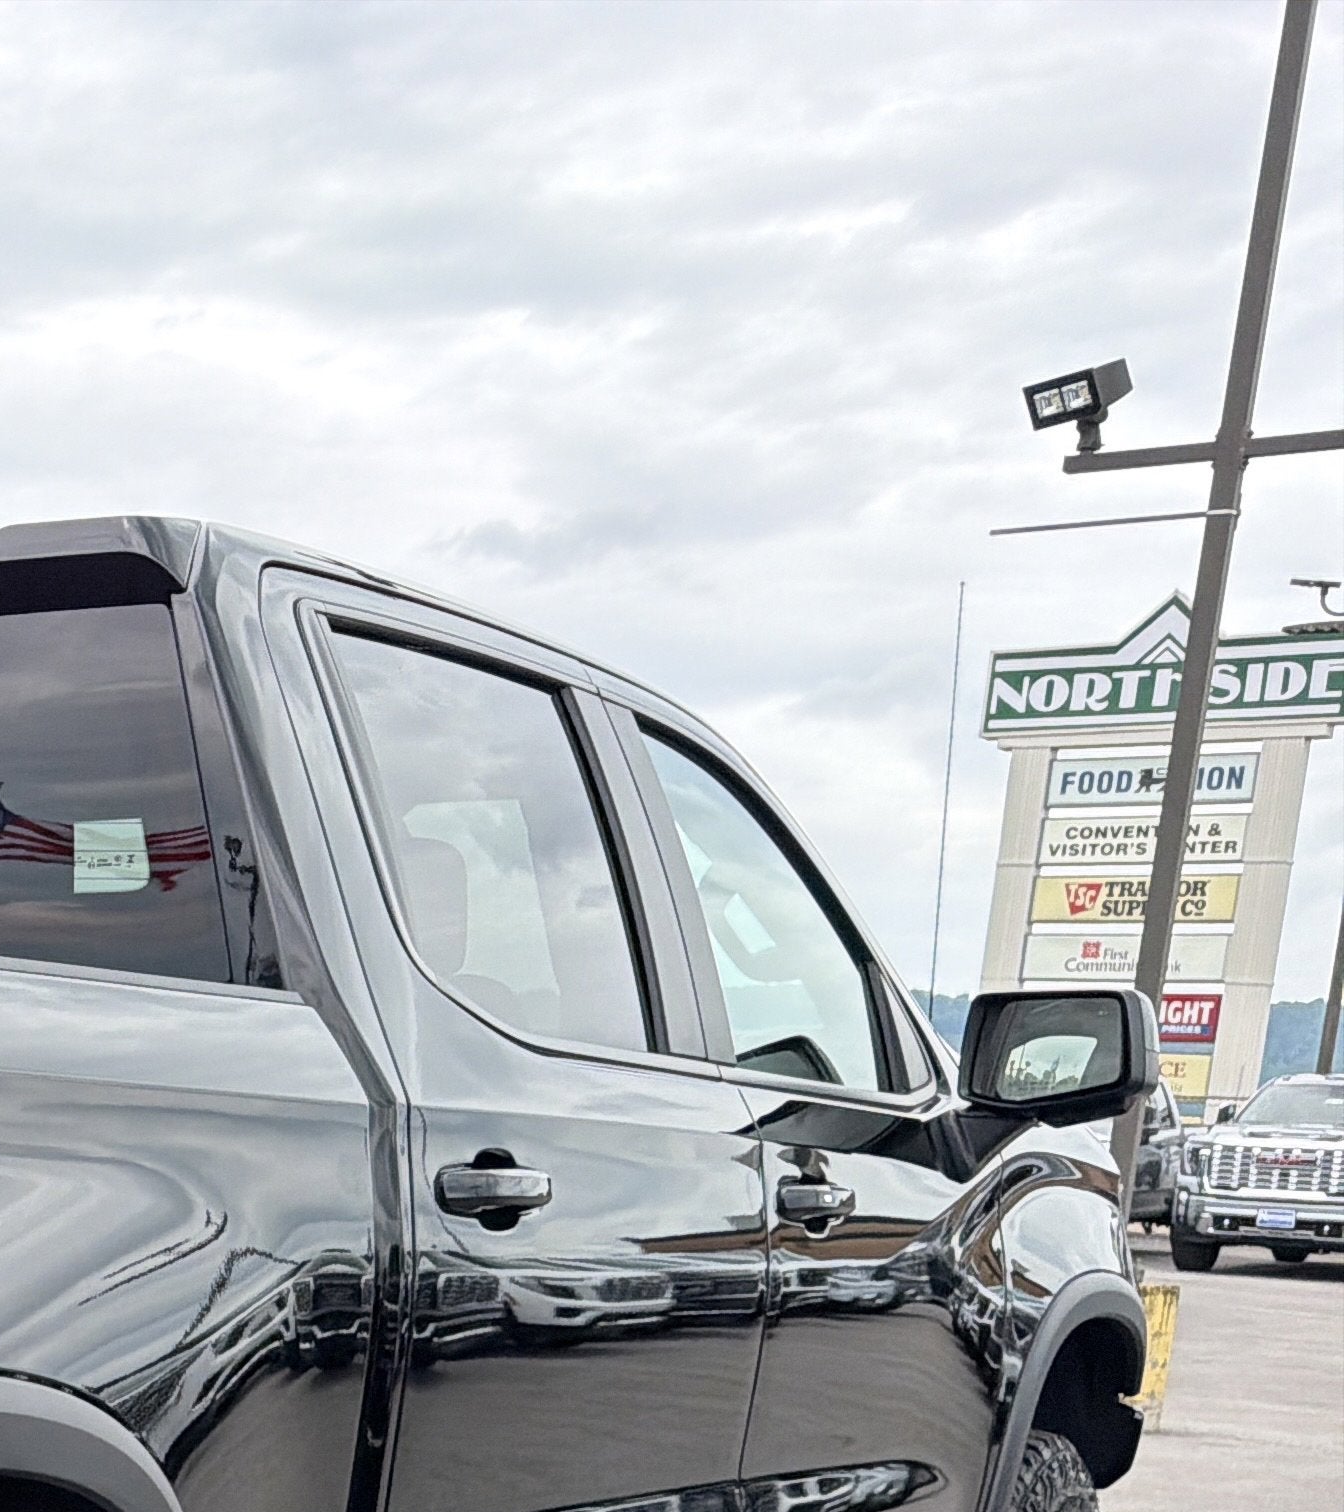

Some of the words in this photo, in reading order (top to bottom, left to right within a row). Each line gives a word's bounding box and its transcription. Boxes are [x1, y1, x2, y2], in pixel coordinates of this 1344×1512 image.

[1060, 769, 1133, 795] FOOD
[1195, 765, 1246, 791] ION
[1207, 823, 1223, 837] &
[1049, 842, 1148, 857] VISITOR'S
[1185, 840, 1238, 854] NTER
[1068, 883, 1097, 910] TSC
[1104, 880, 1207, 898] TRAOR
[1103, 947, 1129, 960] First
[1064, 956, 1135, 973] Communi
